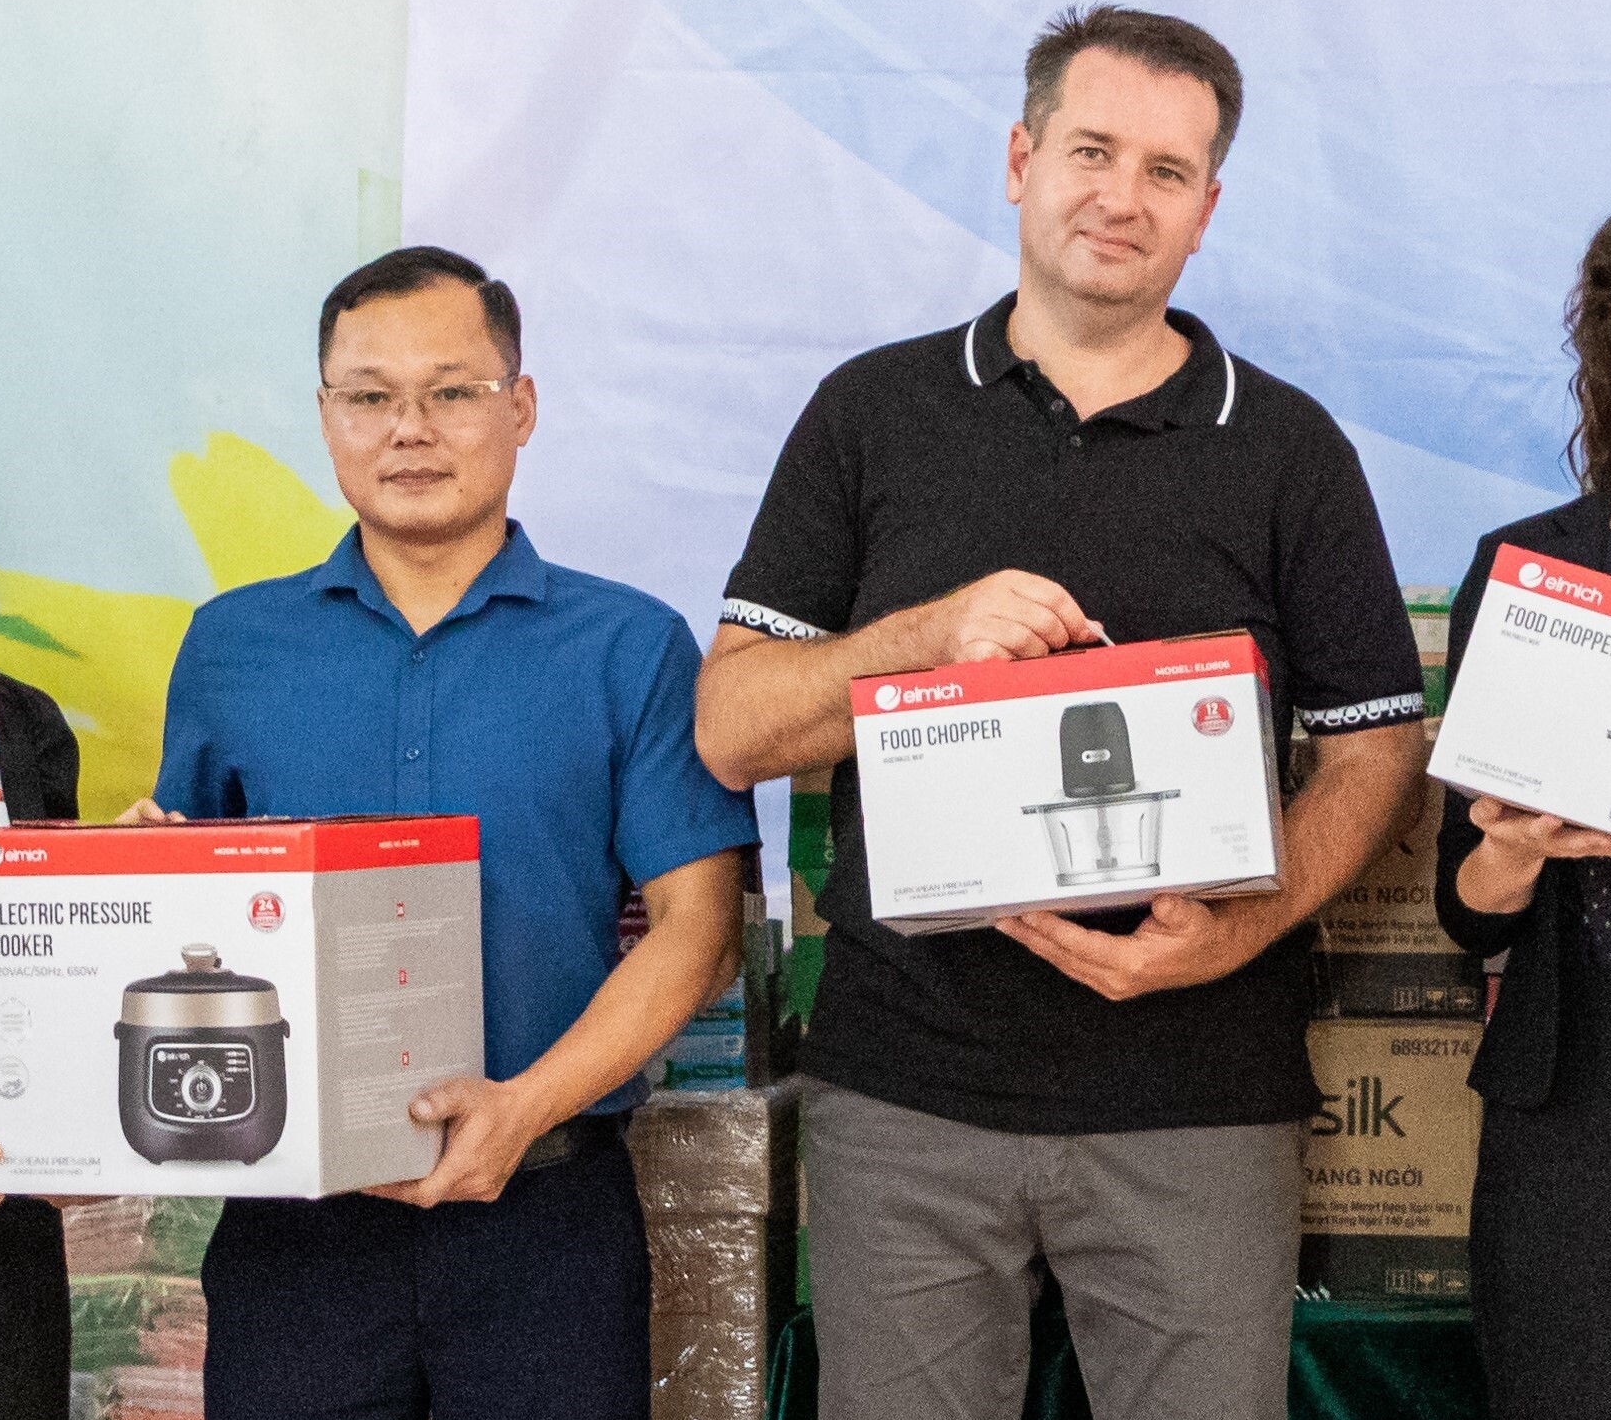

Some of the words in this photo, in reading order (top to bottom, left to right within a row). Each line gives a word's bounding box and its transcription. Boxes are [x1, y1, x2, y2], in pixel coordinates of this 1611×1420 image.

[1545, 576, 1602, 605] elmich
[1505, 604, 1547, 632] FOOD
[903, 683, 964, 704] elmich
[1205, 702, 1219, 715] 12
[880, 726, 923, 751] FOOD
[927, 719, 1002, 746] CHOPPER
[5, 848, 48, 863] elmich
[70, 901, 152, 925] PRESSURE
[257, 898, 273, 912] 24
[66, 966, 99, 977] 650W
